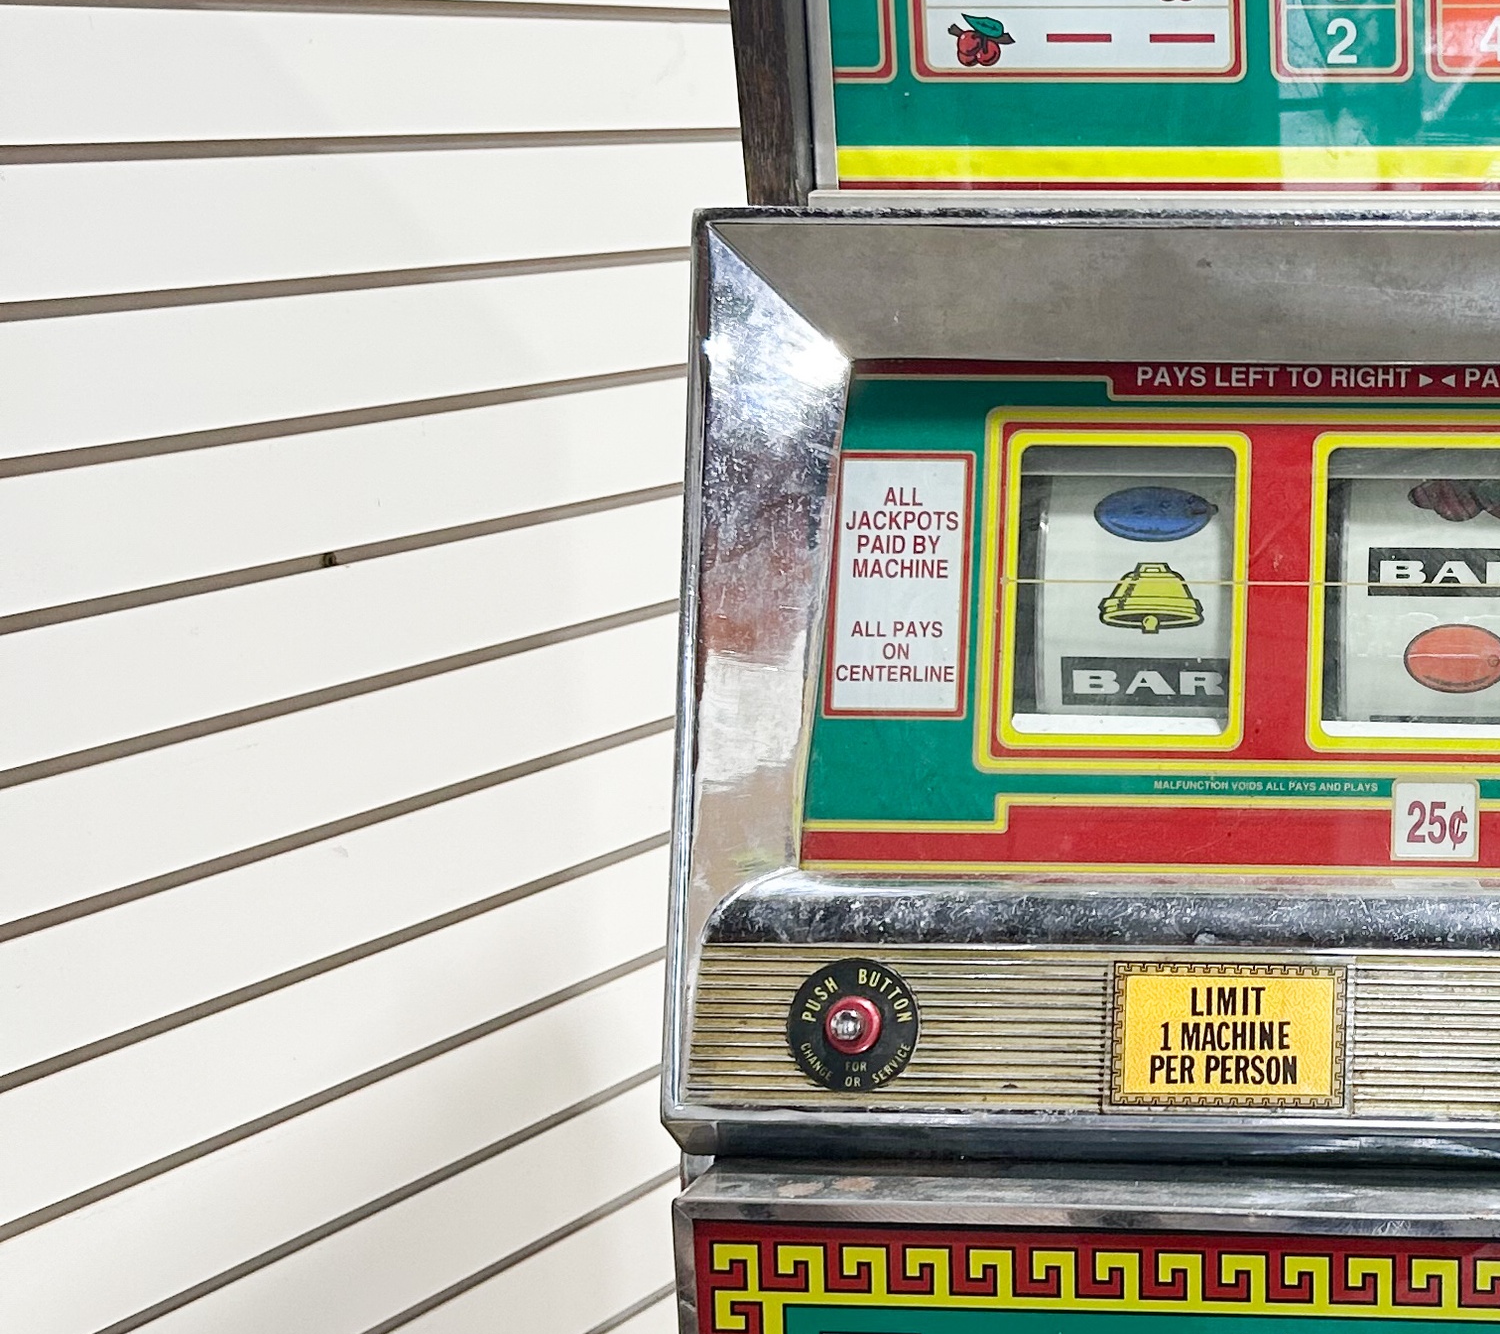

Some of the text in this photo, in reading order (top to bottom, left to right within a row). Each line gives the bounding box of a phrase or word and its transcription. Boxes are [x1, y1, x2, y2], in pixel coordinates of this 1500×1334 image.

[1327, 17, 1357, 64] 2
[1136, 366, 1209, 388] PAYS
[1214, 367, 1276, 388] LEFT
[1282, 367, 1320, 388] TO
[1329, 367, 1409, 389] RIGHT
[883, 487, 924, 507] ALL
[845, 510, 959, 532] JACKPOTS
[856, 534, 942, 555] PAID BY
[852, 558, 949, 579] MACHINE
[851, 620, 943, 638] ALL PAYS
[883, 642, 910, 661] ON
[835, 664, 955, 684] CENTERLINE
[1072, 670, 1224, 697] BAR
[1153, 780, 1378, 792] MALFUNCTION VOIDS ALL PAYS AND PLAYS
[1406, 801, 1468, 849] 25¢
[801, 968, 913, 1023] PUSH BUTTON
[1190, 986, 1264, 1018] LIMIT
[1160, 1021, 1290, 1052] 1 MACHINE
[800, 1042, 911, 1087] CHANGE OR SERVICE
[845, 1061, 867, 1072] FOR
[1149, 1054, 1298, 1086] PER PERSON
